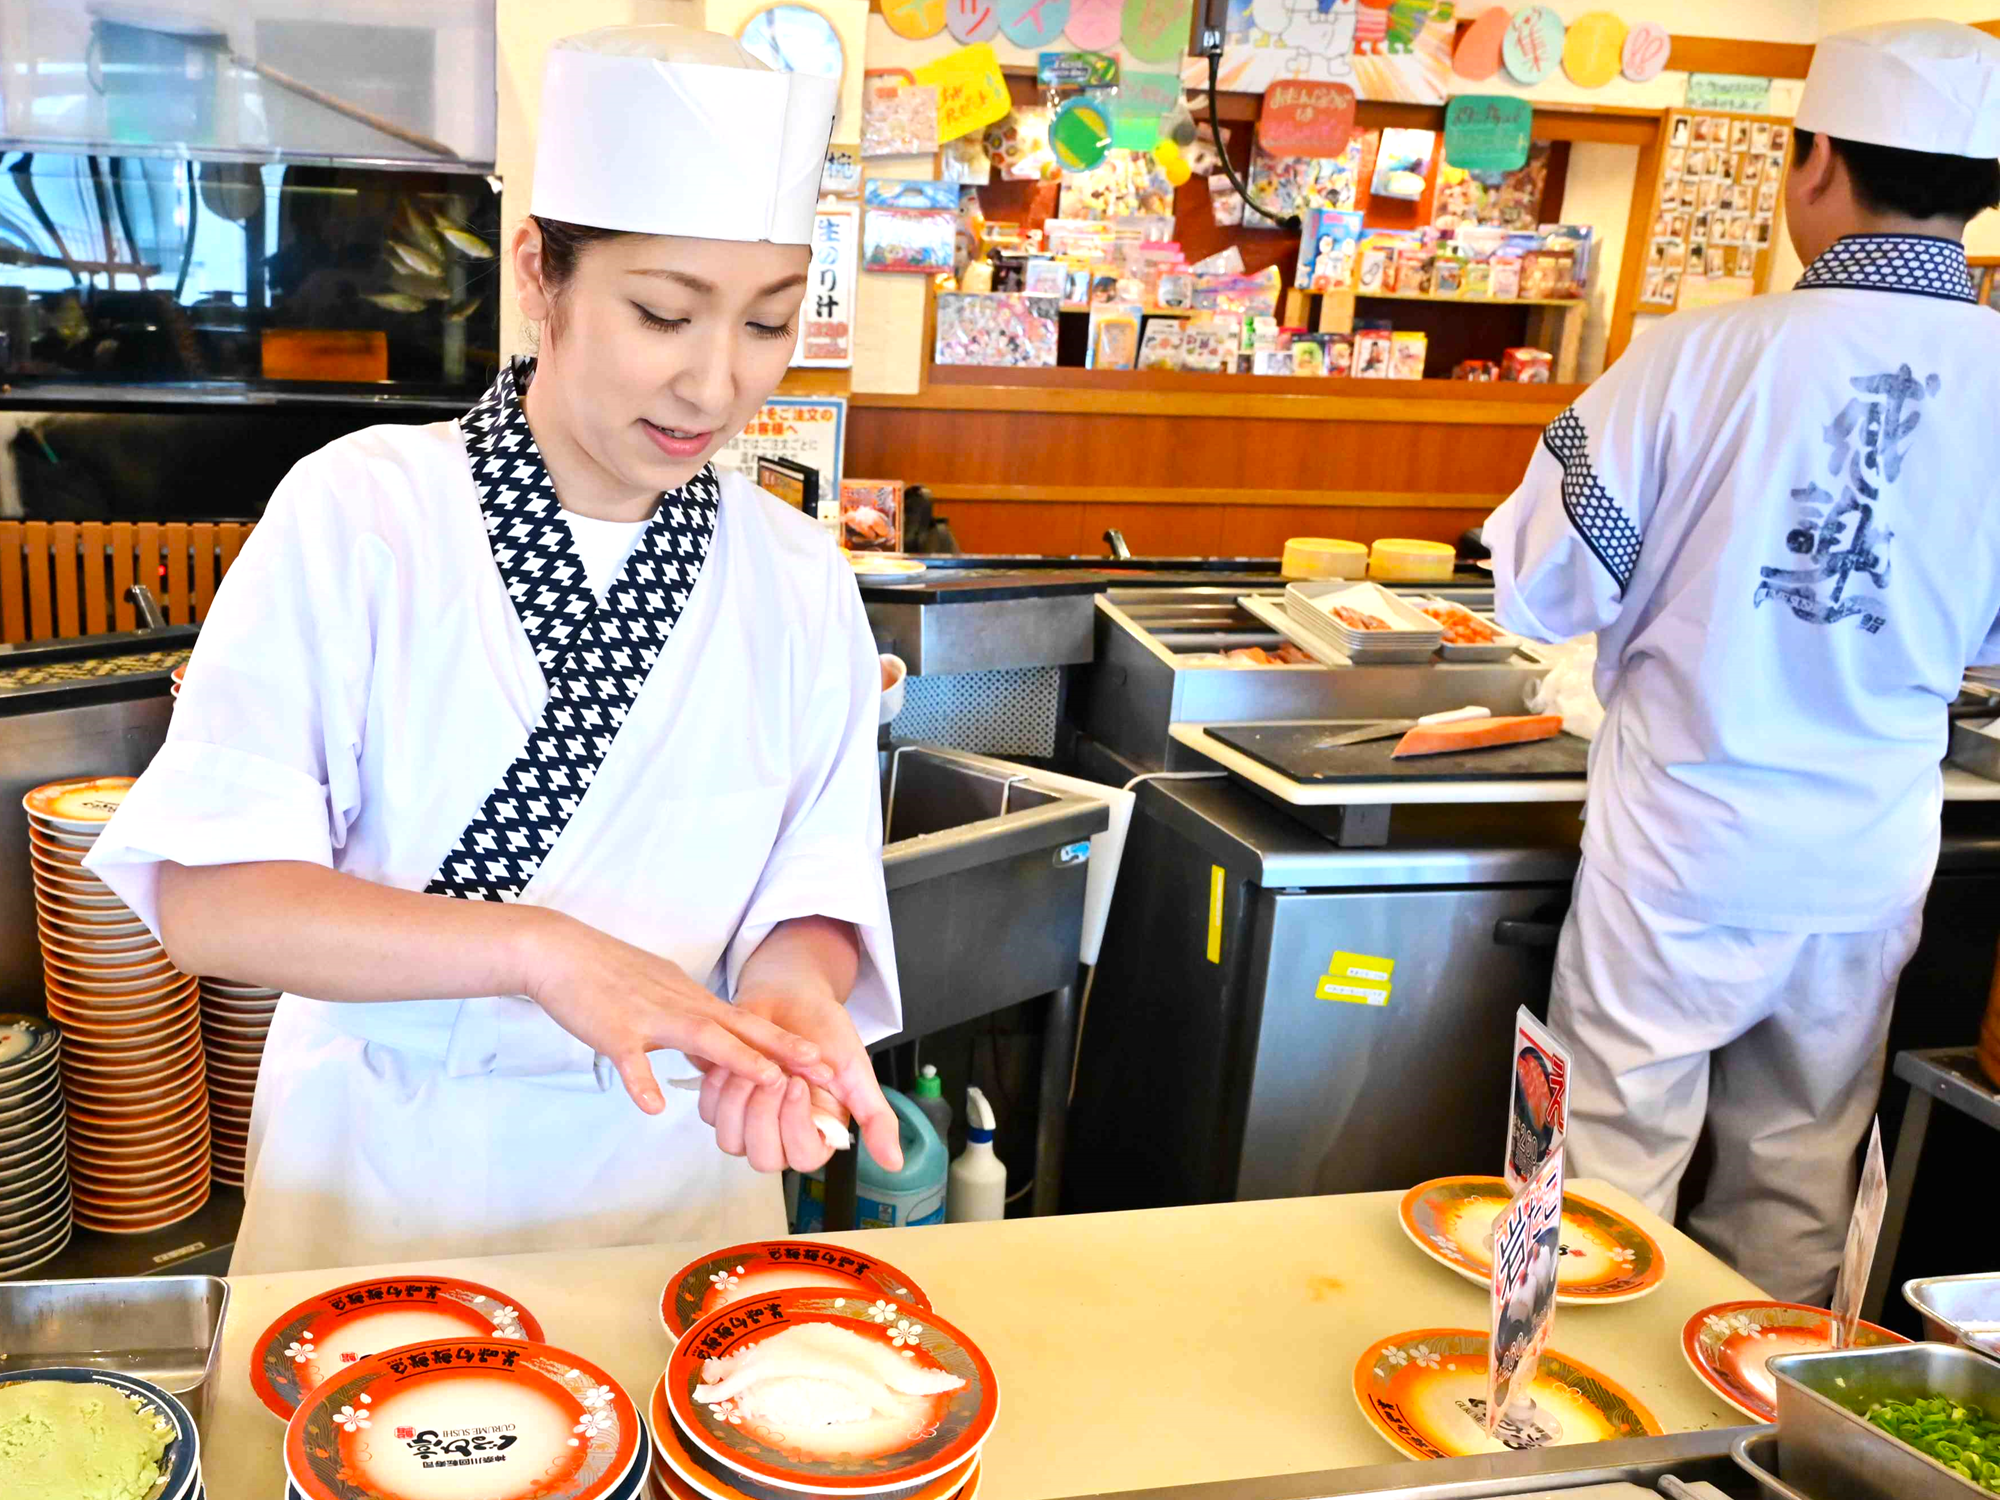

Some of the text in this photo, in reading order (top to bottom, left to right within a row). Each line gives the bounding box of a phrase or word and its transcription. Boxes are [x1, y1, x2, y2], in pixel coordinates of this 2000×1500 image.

[816, 218, 841, 318] 生のり汁
[442, 1423, 516, 1438] GURUME SUSHI
[406, 1430, 518, 1460] ぐるめ亭
[422, 1454, 507, 1469] 神奈川回転寿司
